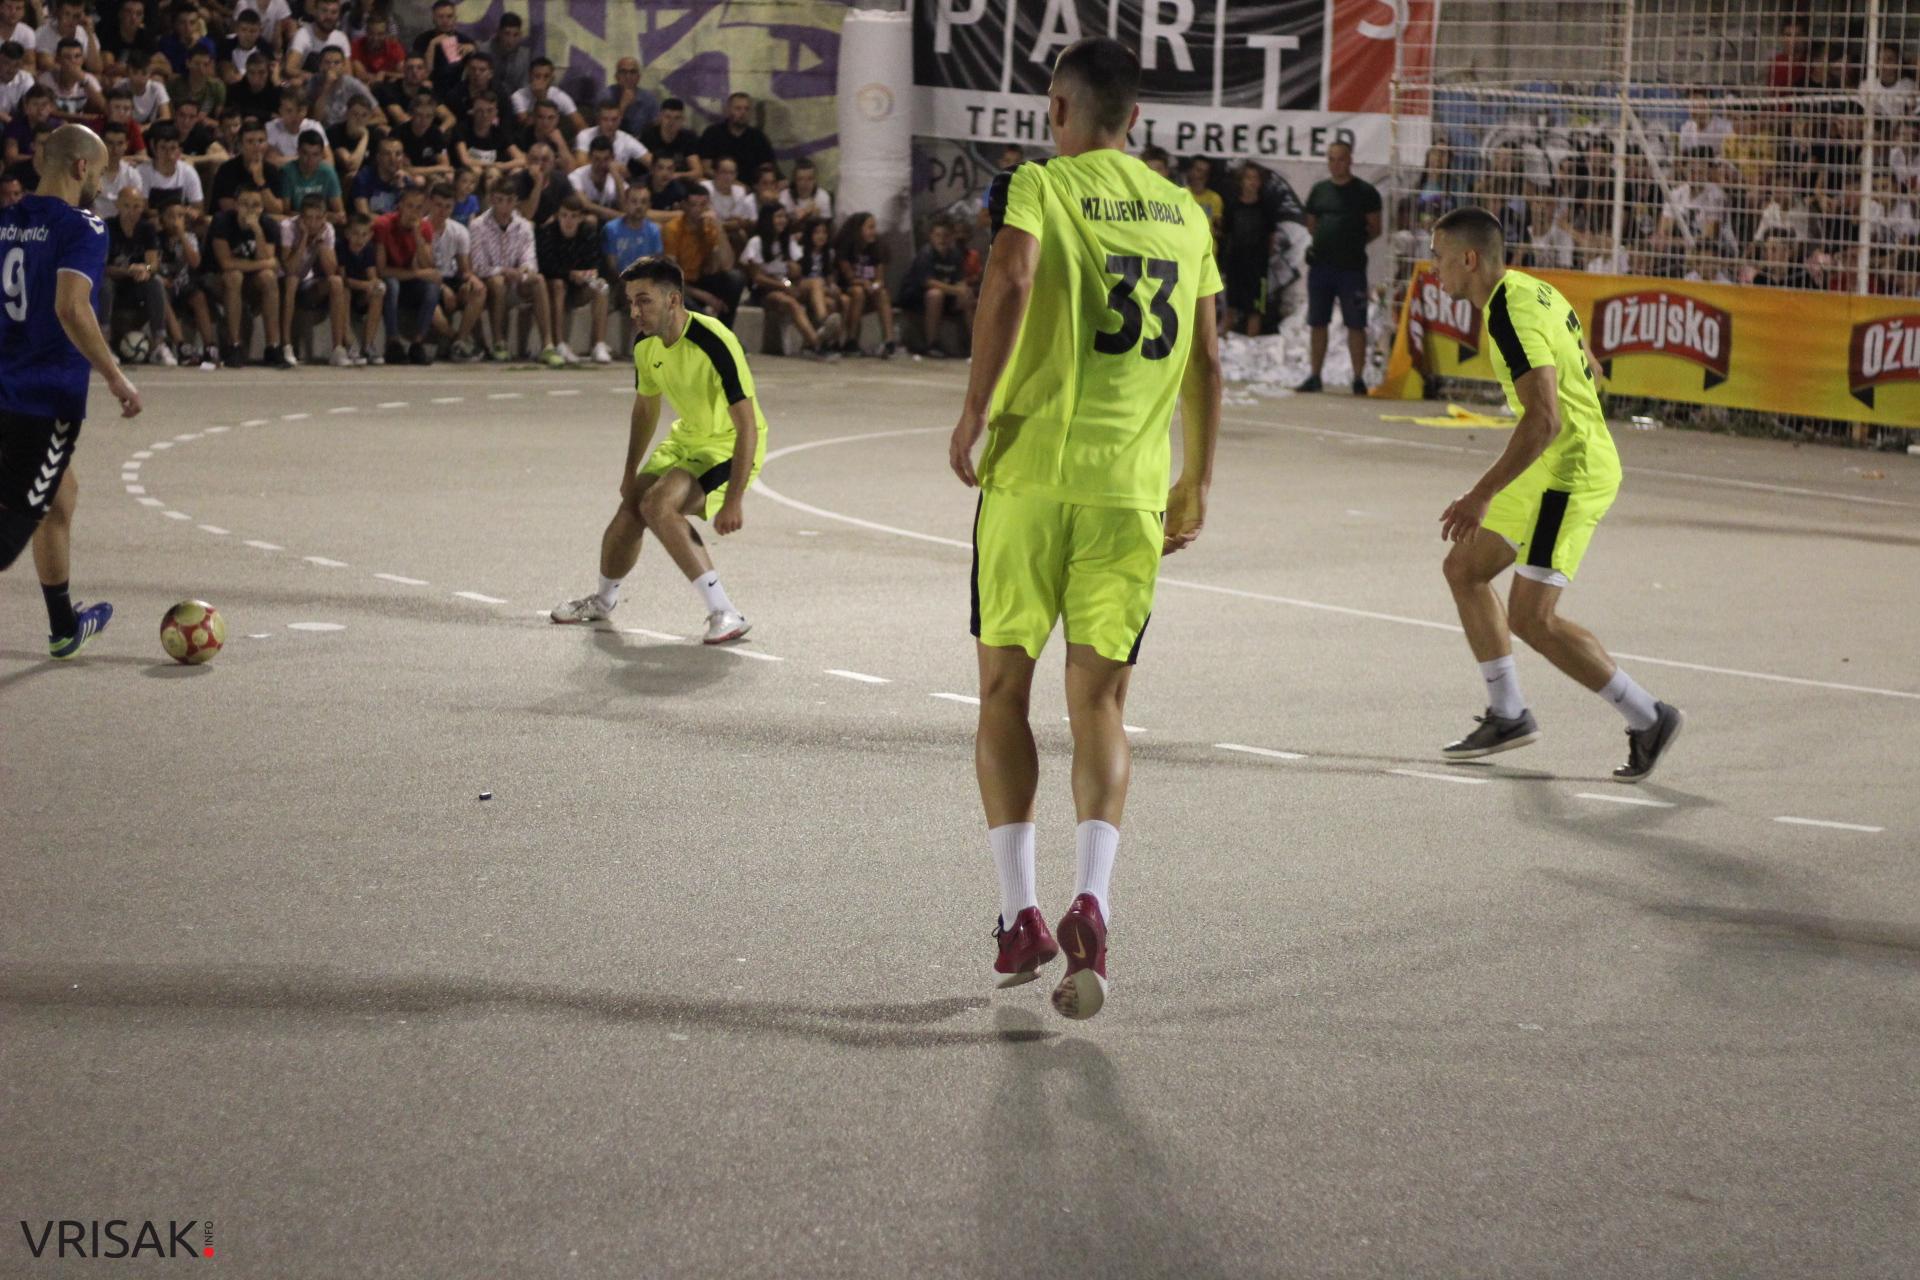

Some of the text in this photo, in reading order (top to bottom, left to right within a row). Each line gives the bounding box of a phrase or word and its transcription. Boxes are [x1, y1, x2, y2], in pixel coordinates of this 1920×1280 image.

[1081, 198, 1184, 226] MZ LIJEVA OBALA
[2, 247, 28, 322] 9
[1094, 255, 1179, 361] 33
[1602, 294, 1720, 359] Ožujsko
